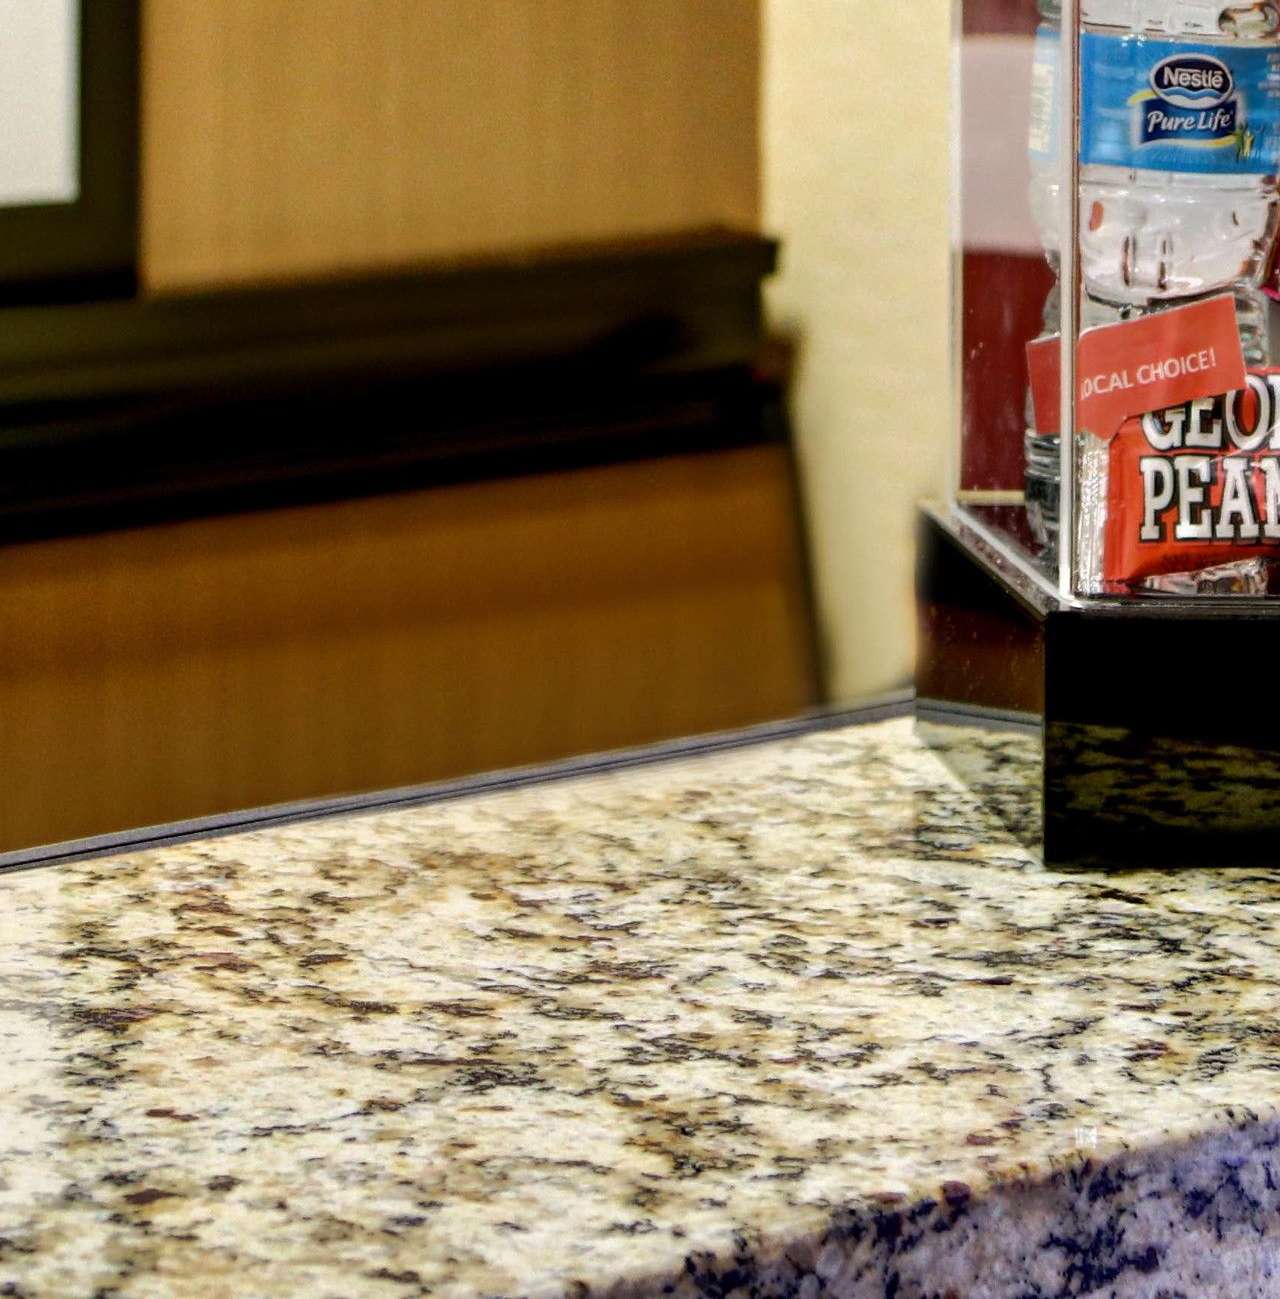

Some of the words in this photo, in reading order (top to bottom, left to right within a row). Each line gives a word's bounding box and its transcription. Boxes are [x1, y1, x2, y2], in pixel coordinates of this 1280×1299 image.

[1163, 66, 1224, 88] Nestlé
[1148, 110, 1197, 133] Pure
[1198, 108, 1233, 131] Life
[1081, 370, 1134, 400] OCAL
[1137, 347, 1217, 384] CHOICE!
